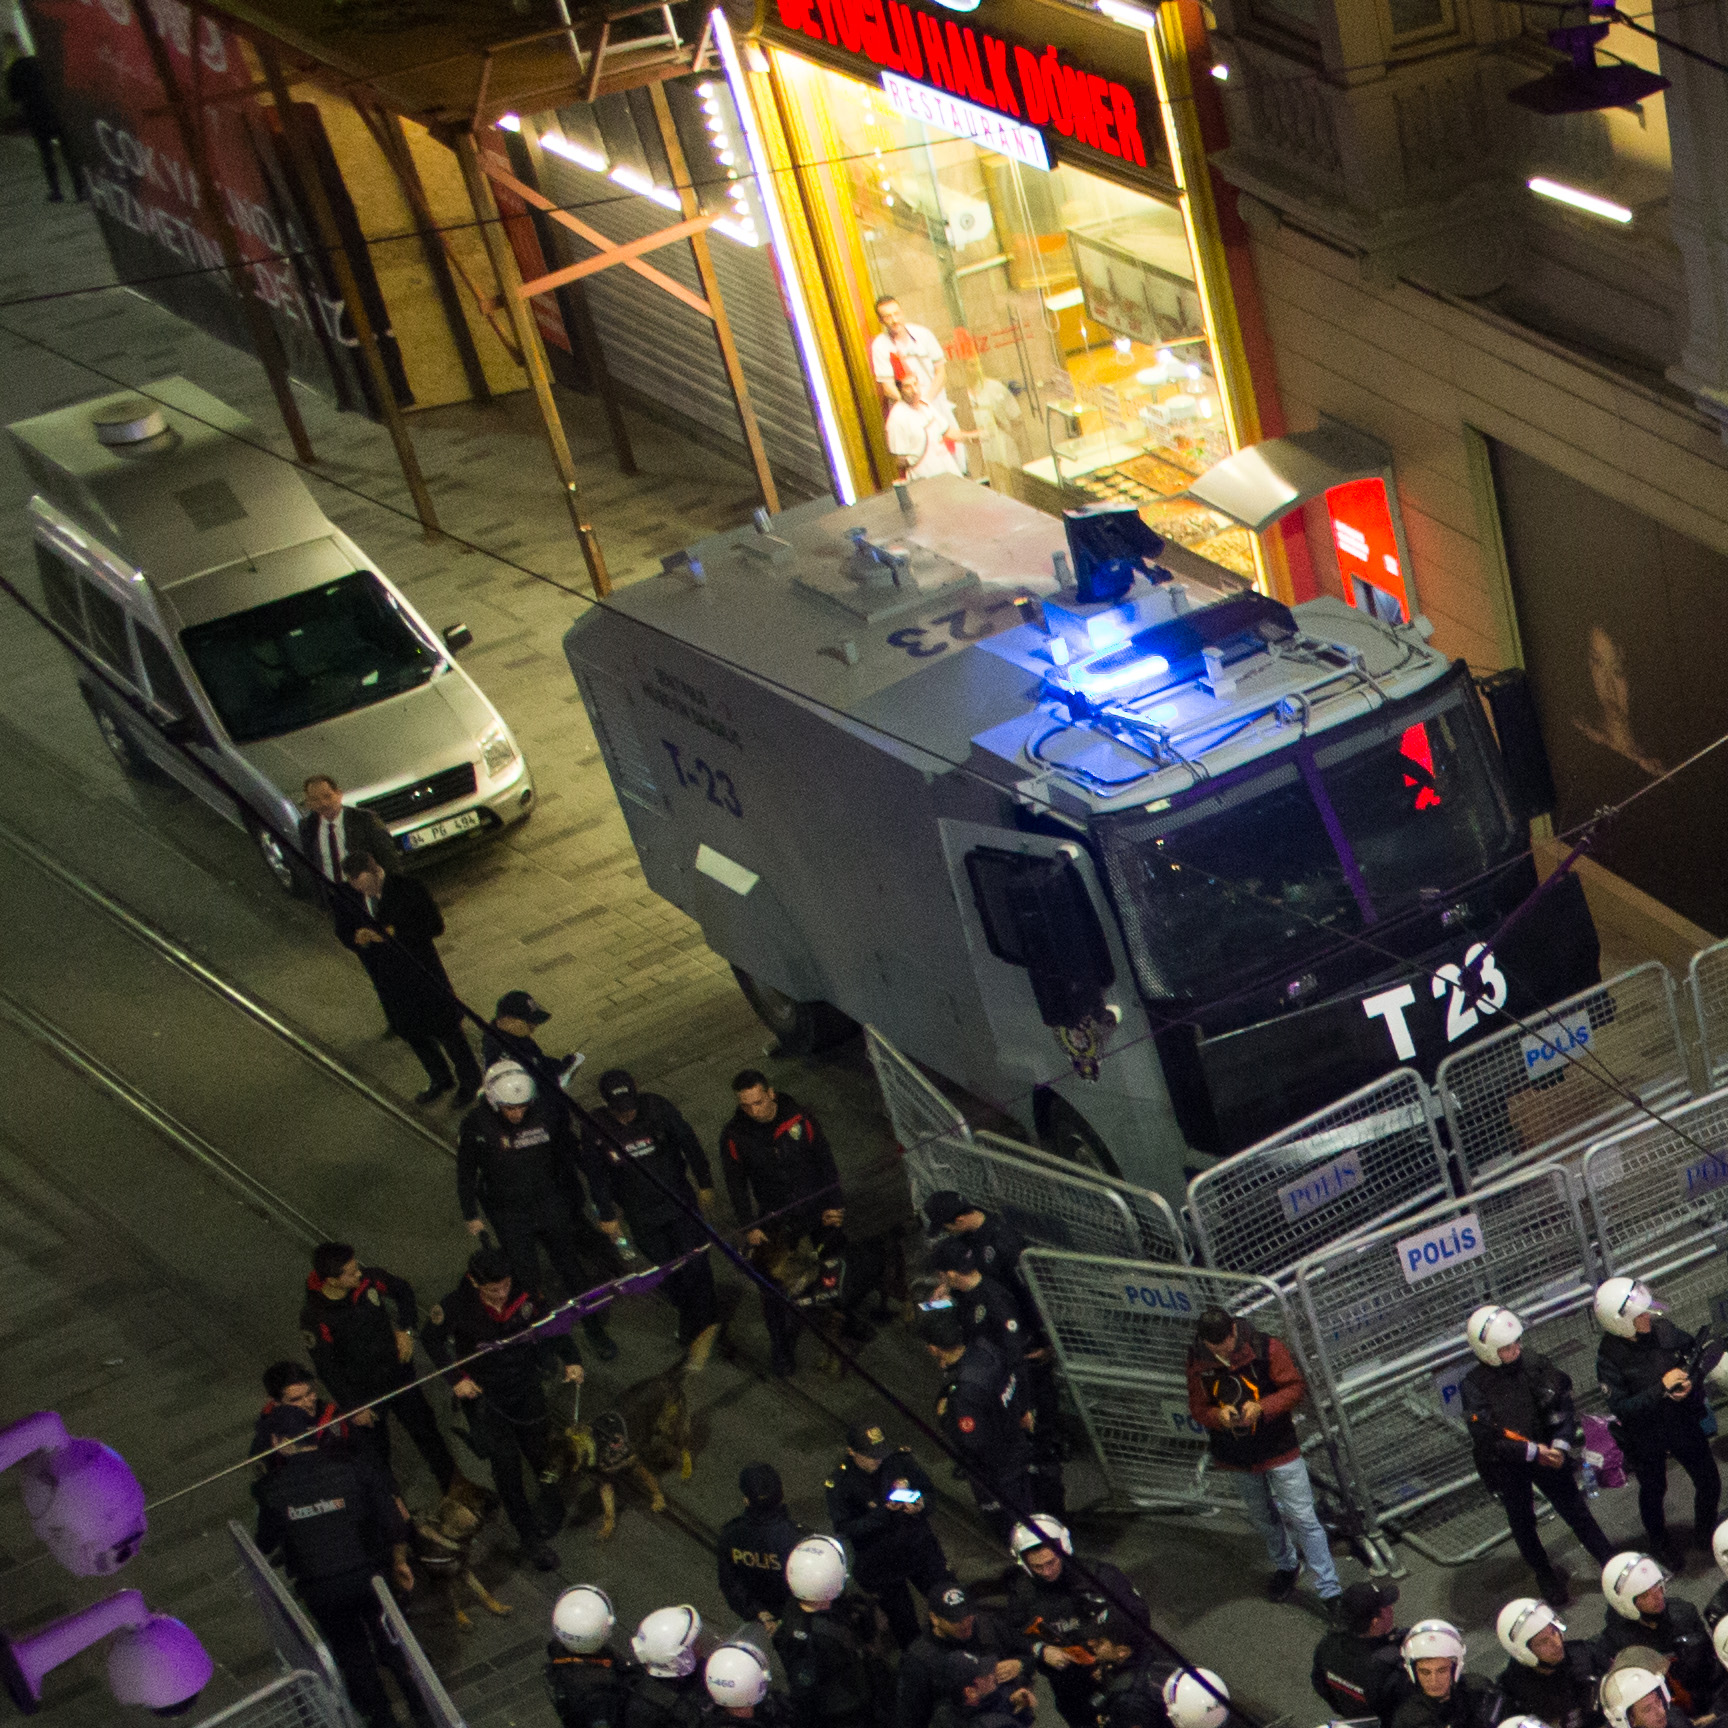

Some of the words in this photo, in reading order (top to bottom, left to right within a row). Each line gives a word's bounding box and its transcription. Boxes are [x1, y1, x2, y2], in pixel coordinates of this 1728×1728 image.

[888, 80, 1043, 163] RESTAURANT
[917, 12, 1020, 117] HALK
[1015, 46, 1147, 168] DÖNER
[661, 739, 743, 818] T-23
[1362, 984, 1416, 1062] T
[1431, 943, 1506, 1043] 23
[1526, 1026, 1588, 1066] POLİS
[1408, 1227, 1476, 1271] POLİS
[1125, 1285, 1191, 1312] POLİS
